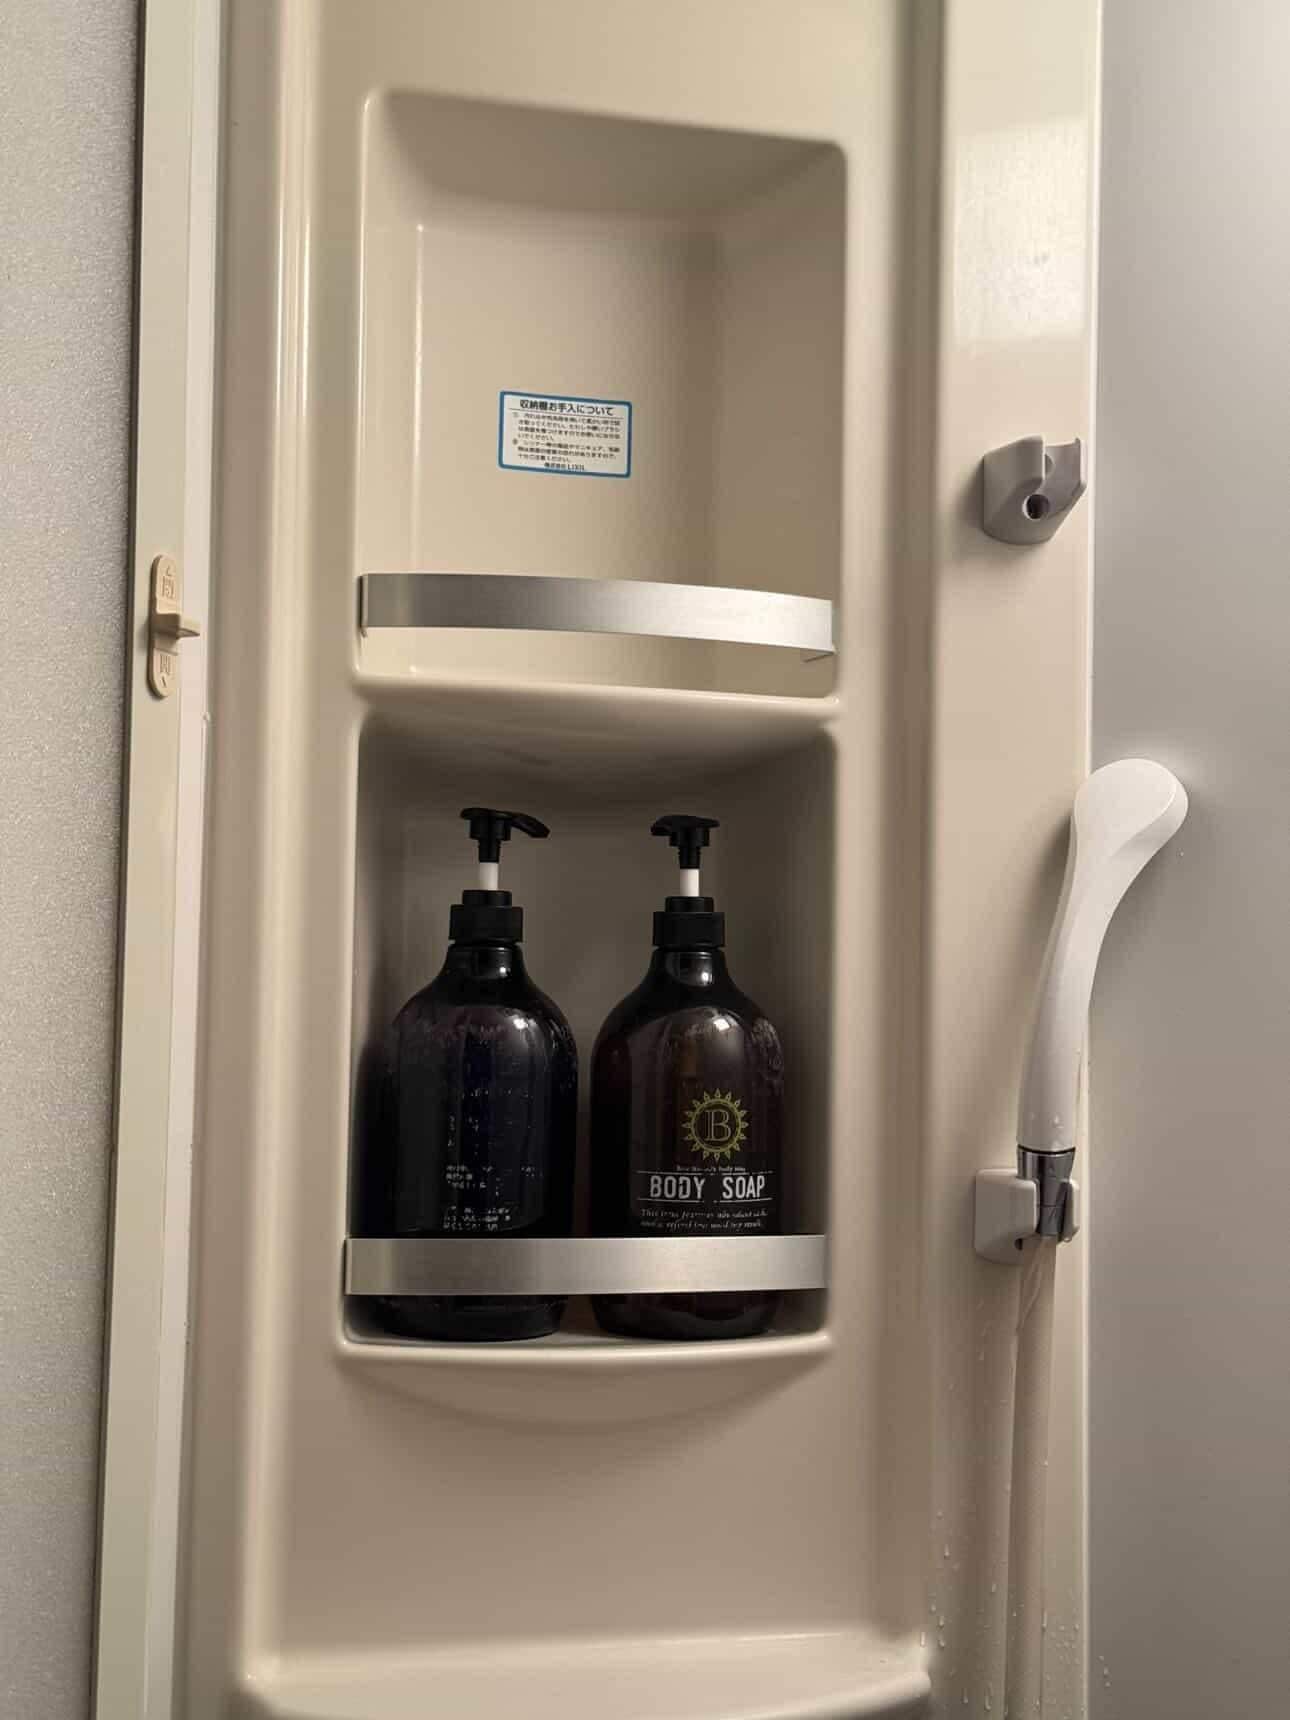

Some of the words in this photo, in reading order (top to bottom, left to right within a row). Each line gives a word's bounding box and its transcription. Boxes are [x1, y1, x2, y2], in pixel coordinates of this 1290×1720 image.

[519, 399, 615, 416] 収納棚お手入について
[704, 1109, 732, 1142] B
[650, 1175, 706, 1199] BODY
[722, 1175, 766, 1199] SOAP
